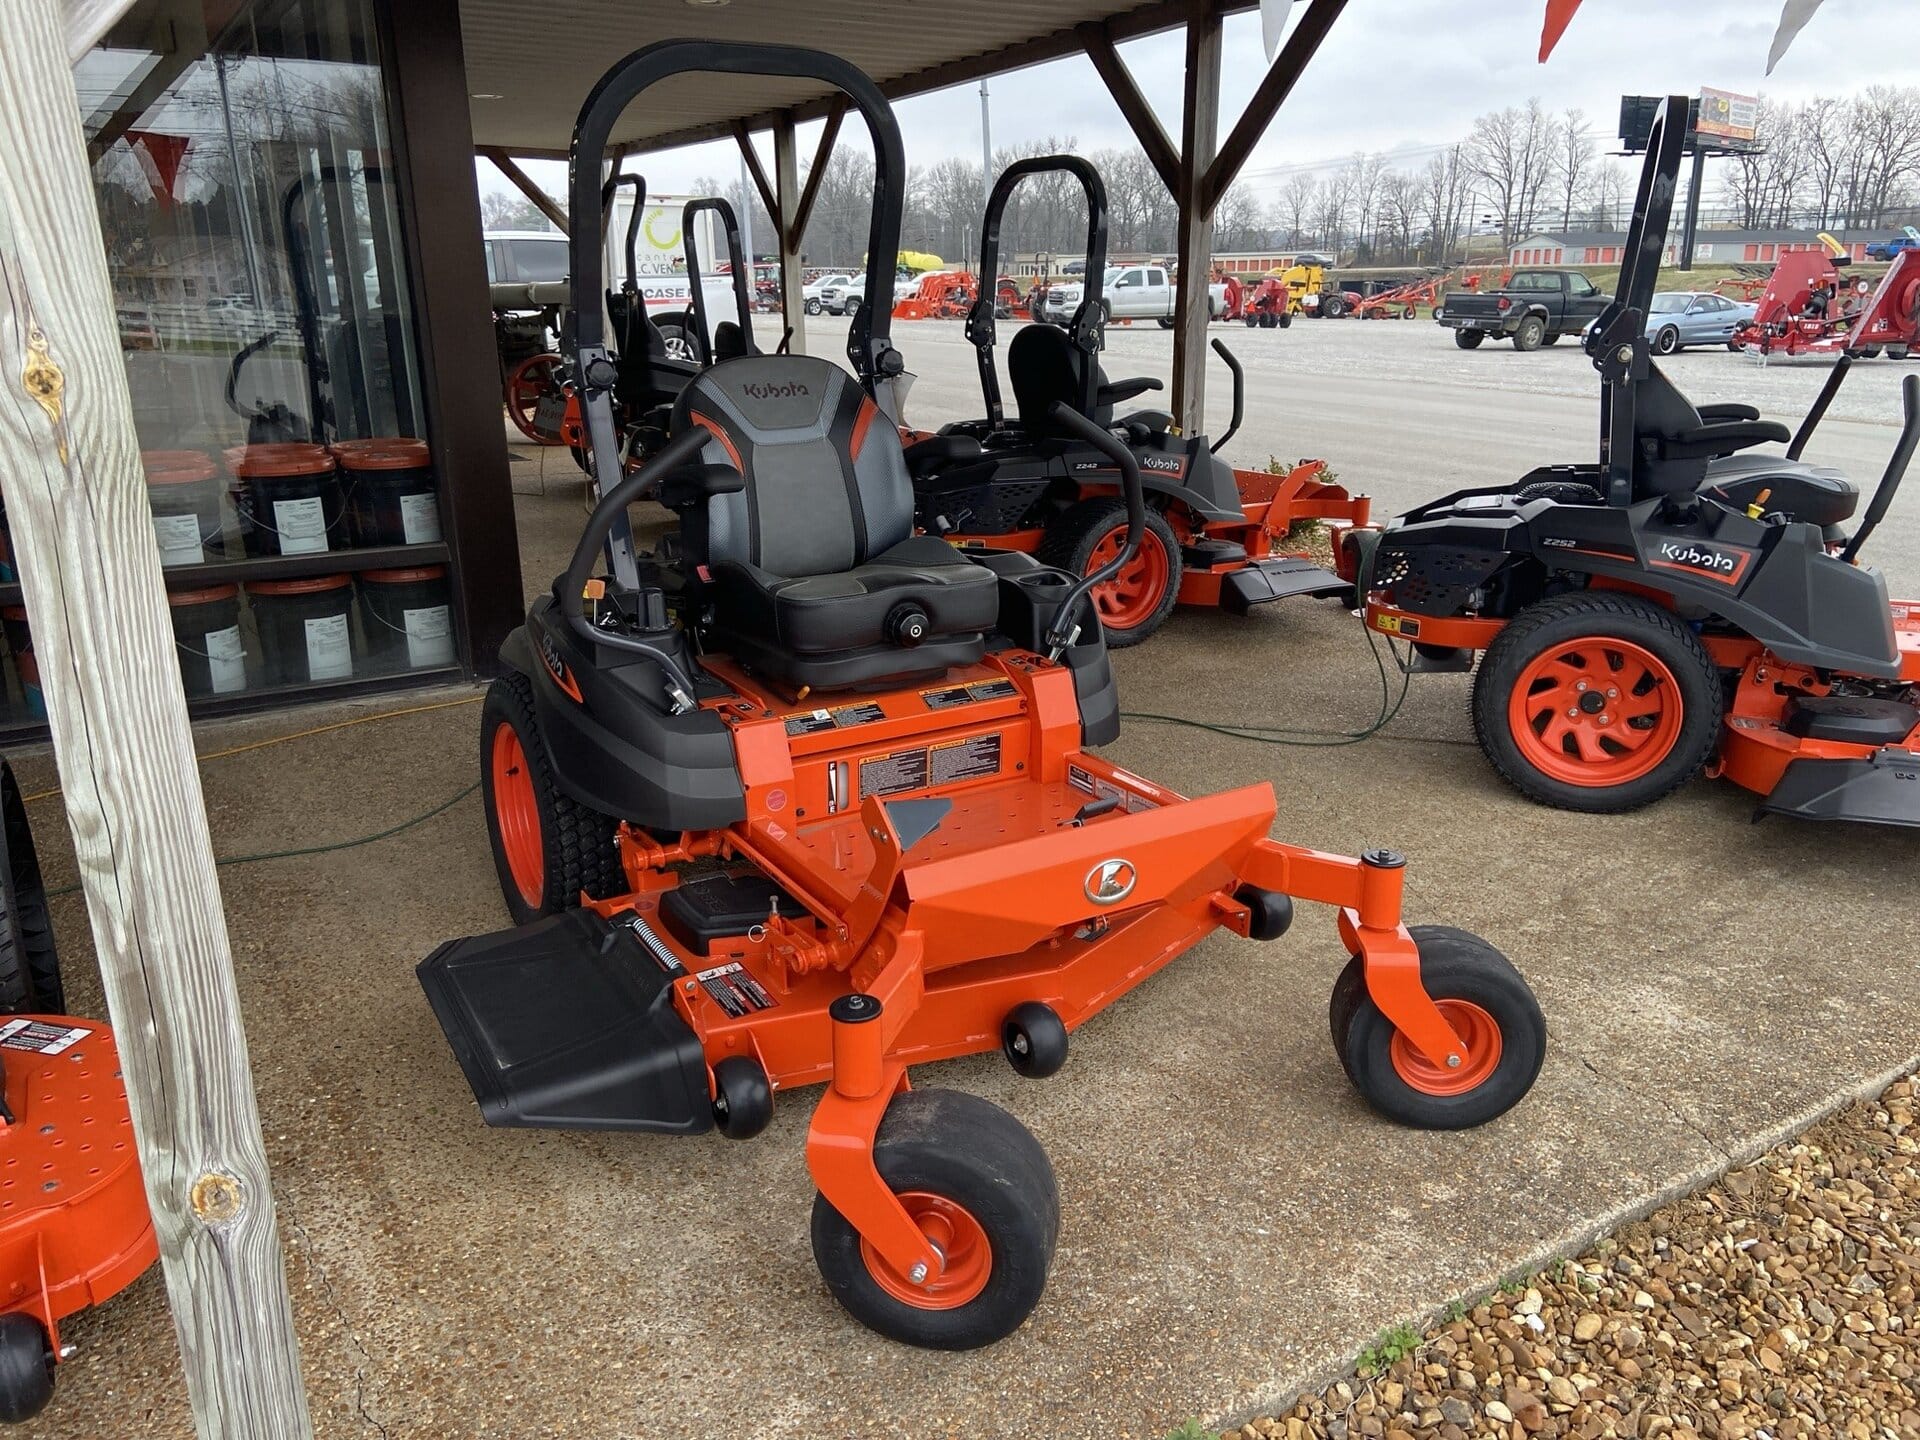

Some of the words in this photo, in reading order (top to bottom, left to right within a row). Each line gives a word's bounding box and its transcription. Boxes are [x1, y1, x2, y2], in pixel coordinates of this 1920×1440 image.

[644, 287, 686, 299] CASE
[742, 381, 809, 399] Kubota
[1143, 456, 1180, 471] Kubota
[1543, 537, 1577, 548] Z252
[1660, 542, 1734, 571] Kubota
